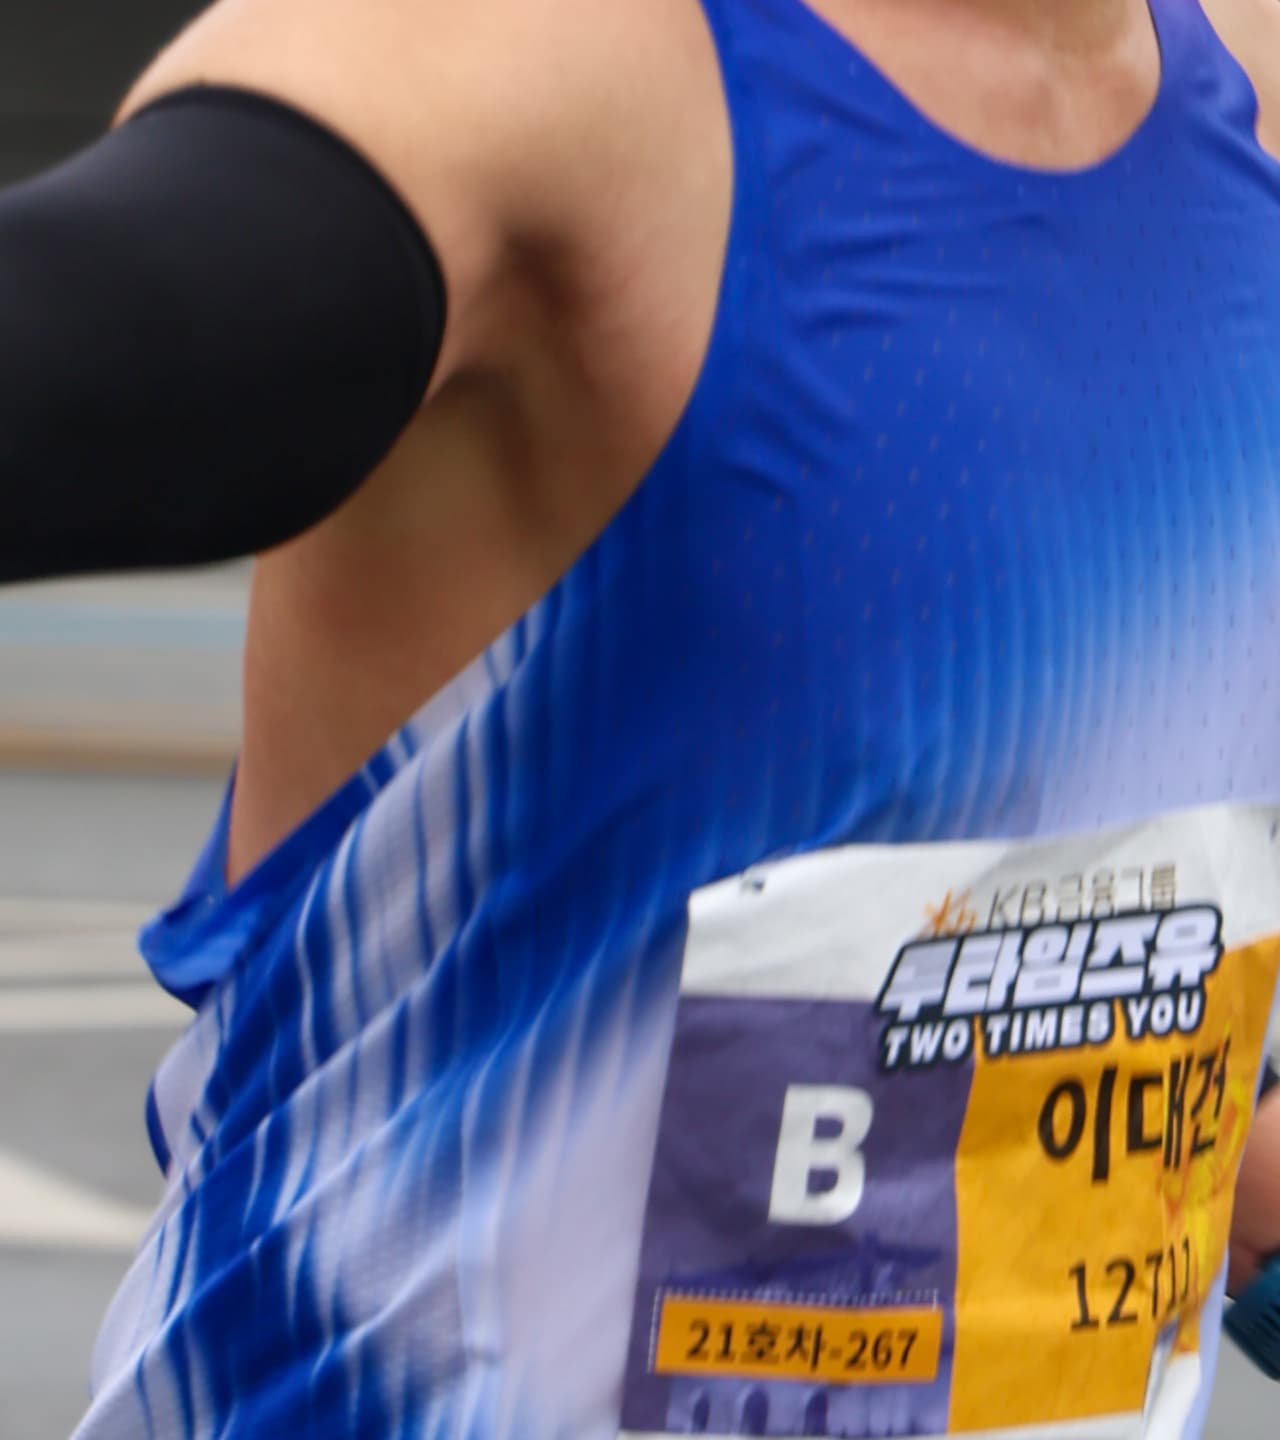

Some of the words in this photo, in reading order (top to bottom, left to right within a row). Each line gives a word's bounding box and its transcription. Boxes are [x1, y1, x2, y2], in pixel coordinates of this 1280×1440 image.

[883, 1018, 972, 1067] TWO
[986, 1003, 1114, 1056] TIMES
[1126, 989, 1202, 1039] YOU
[767, 1083, 874, 1226] B
[685, 1318, 919, 1372] 21호차-267
